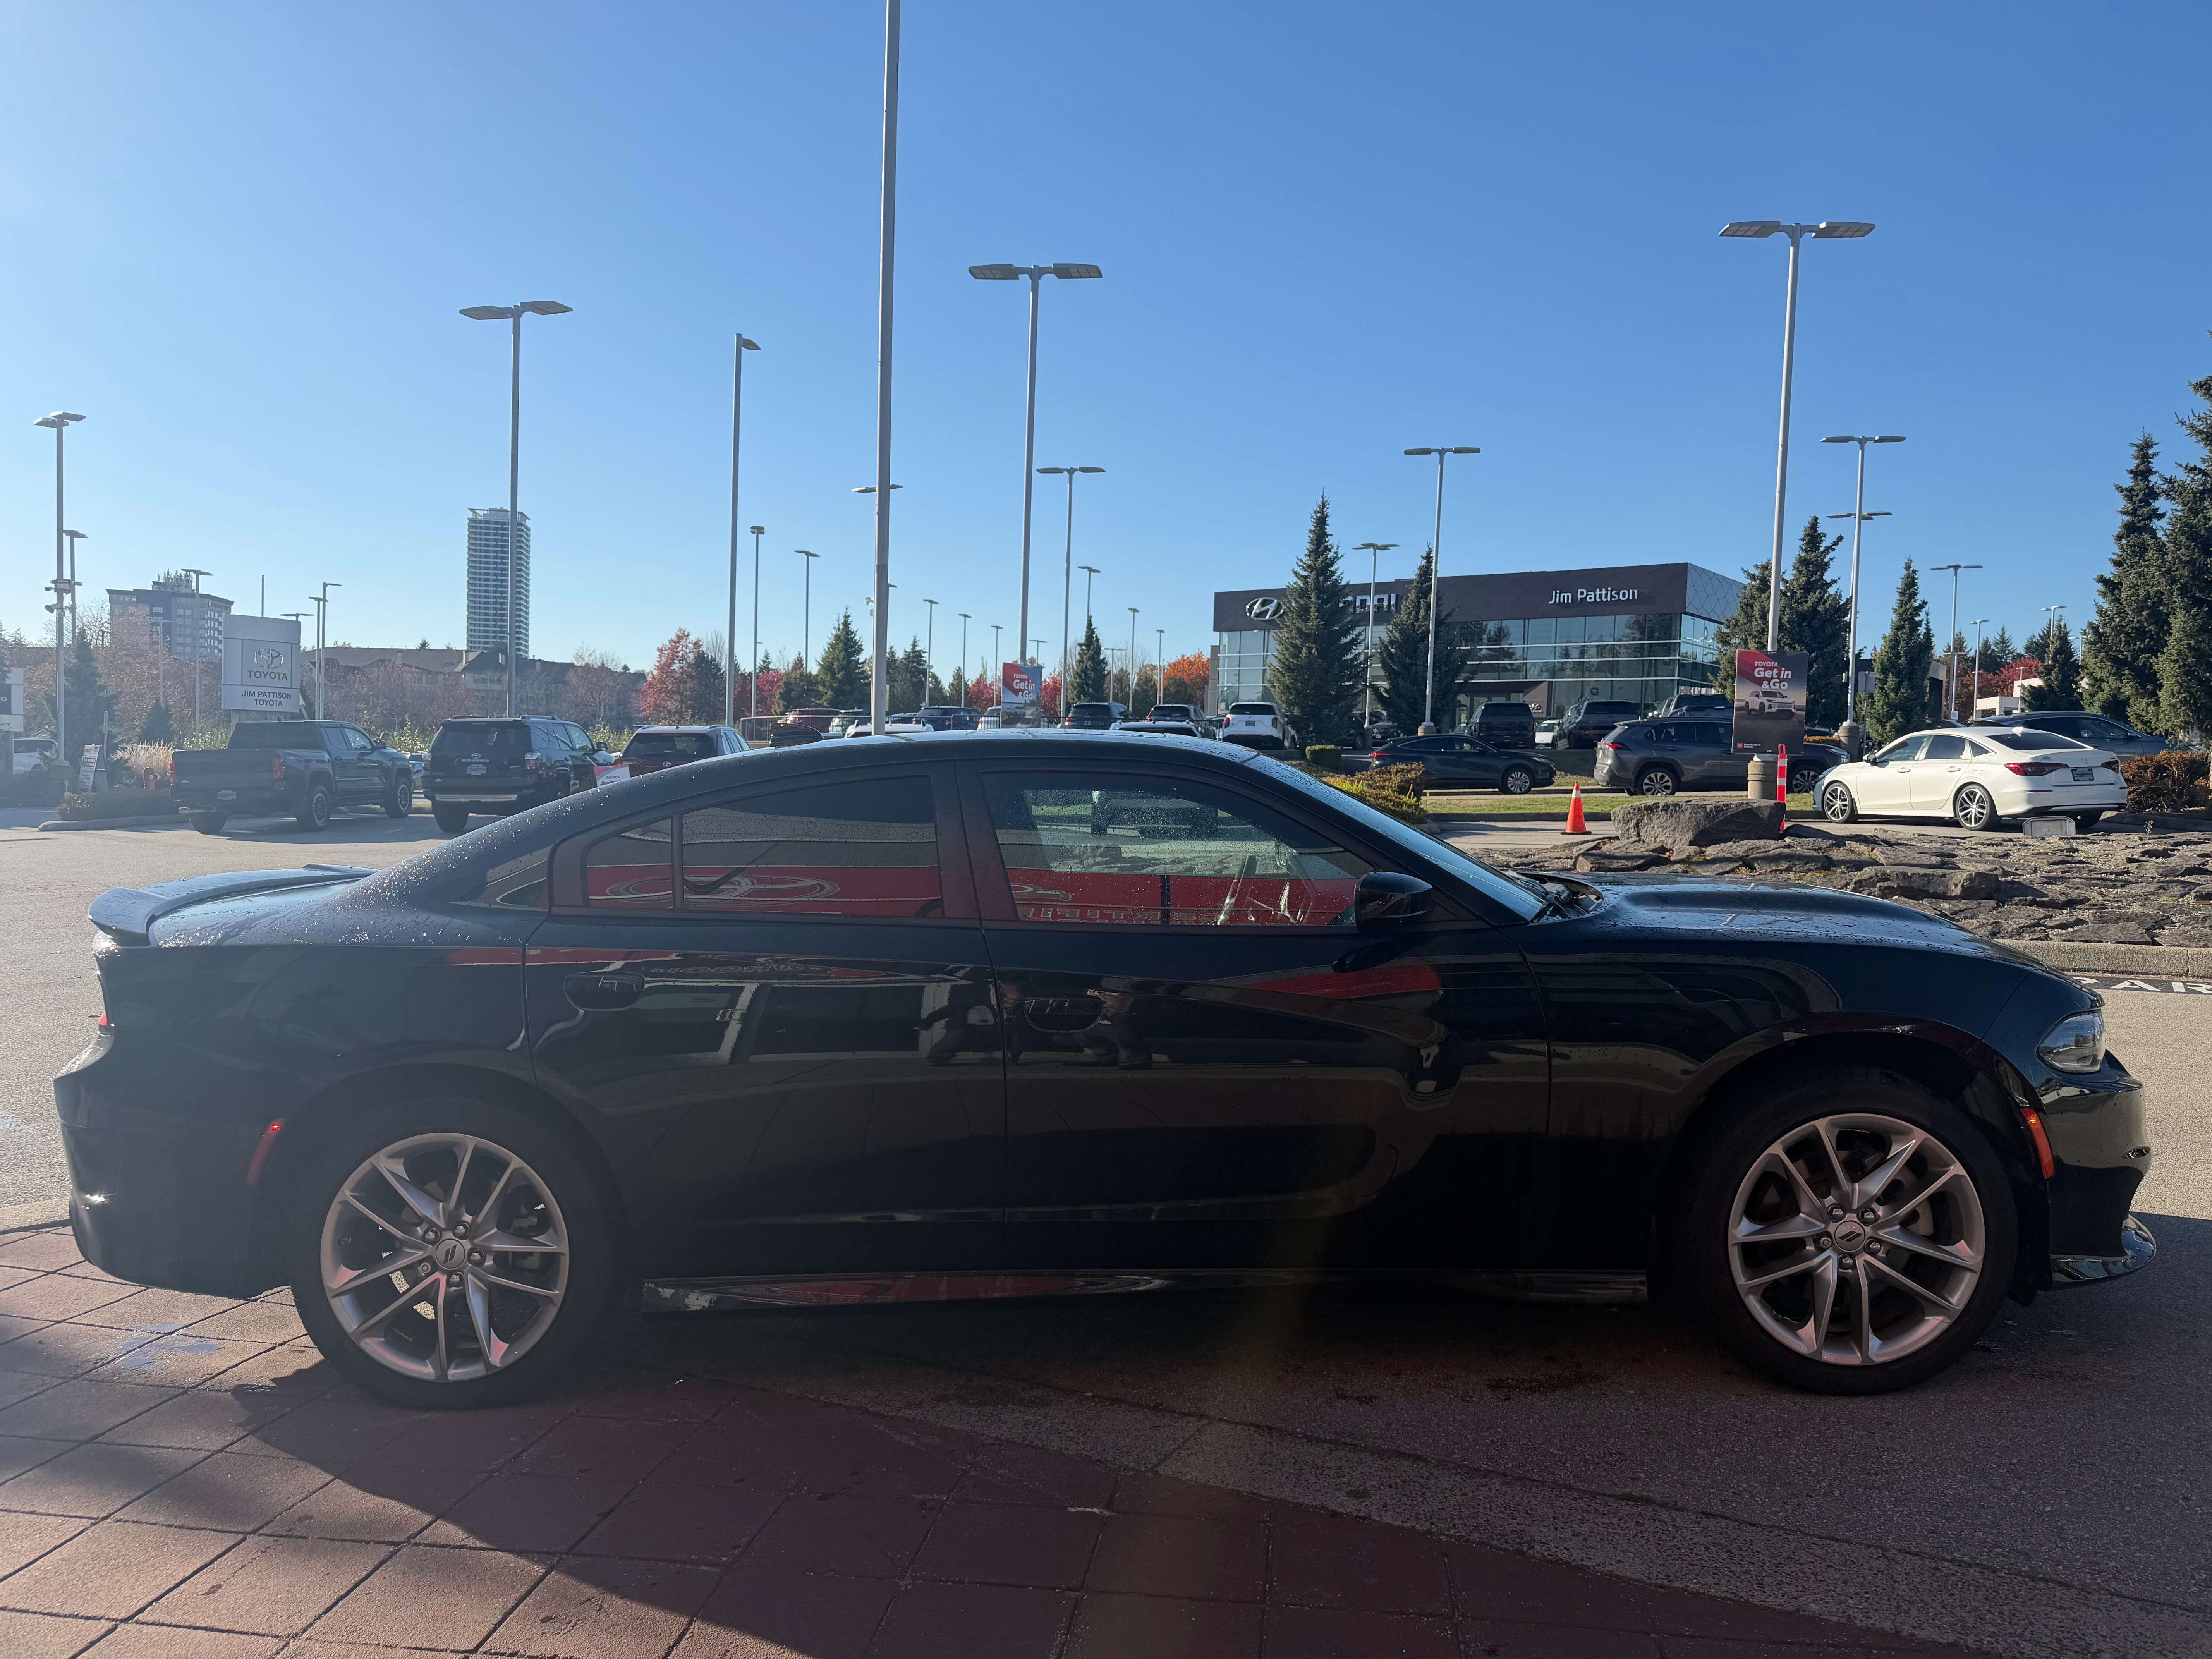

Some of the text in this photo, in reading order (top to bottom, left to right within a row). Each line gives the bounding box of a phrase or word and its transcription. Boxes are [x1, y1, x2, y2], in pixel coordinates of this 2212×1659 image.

[1548, 587, 1638, 604] Jim Pattison
[247, 670, 287, 680] TOYOTA
[1754, 667, 1792, 678] Get in
[1013, 679, 1035, 690] Get in
